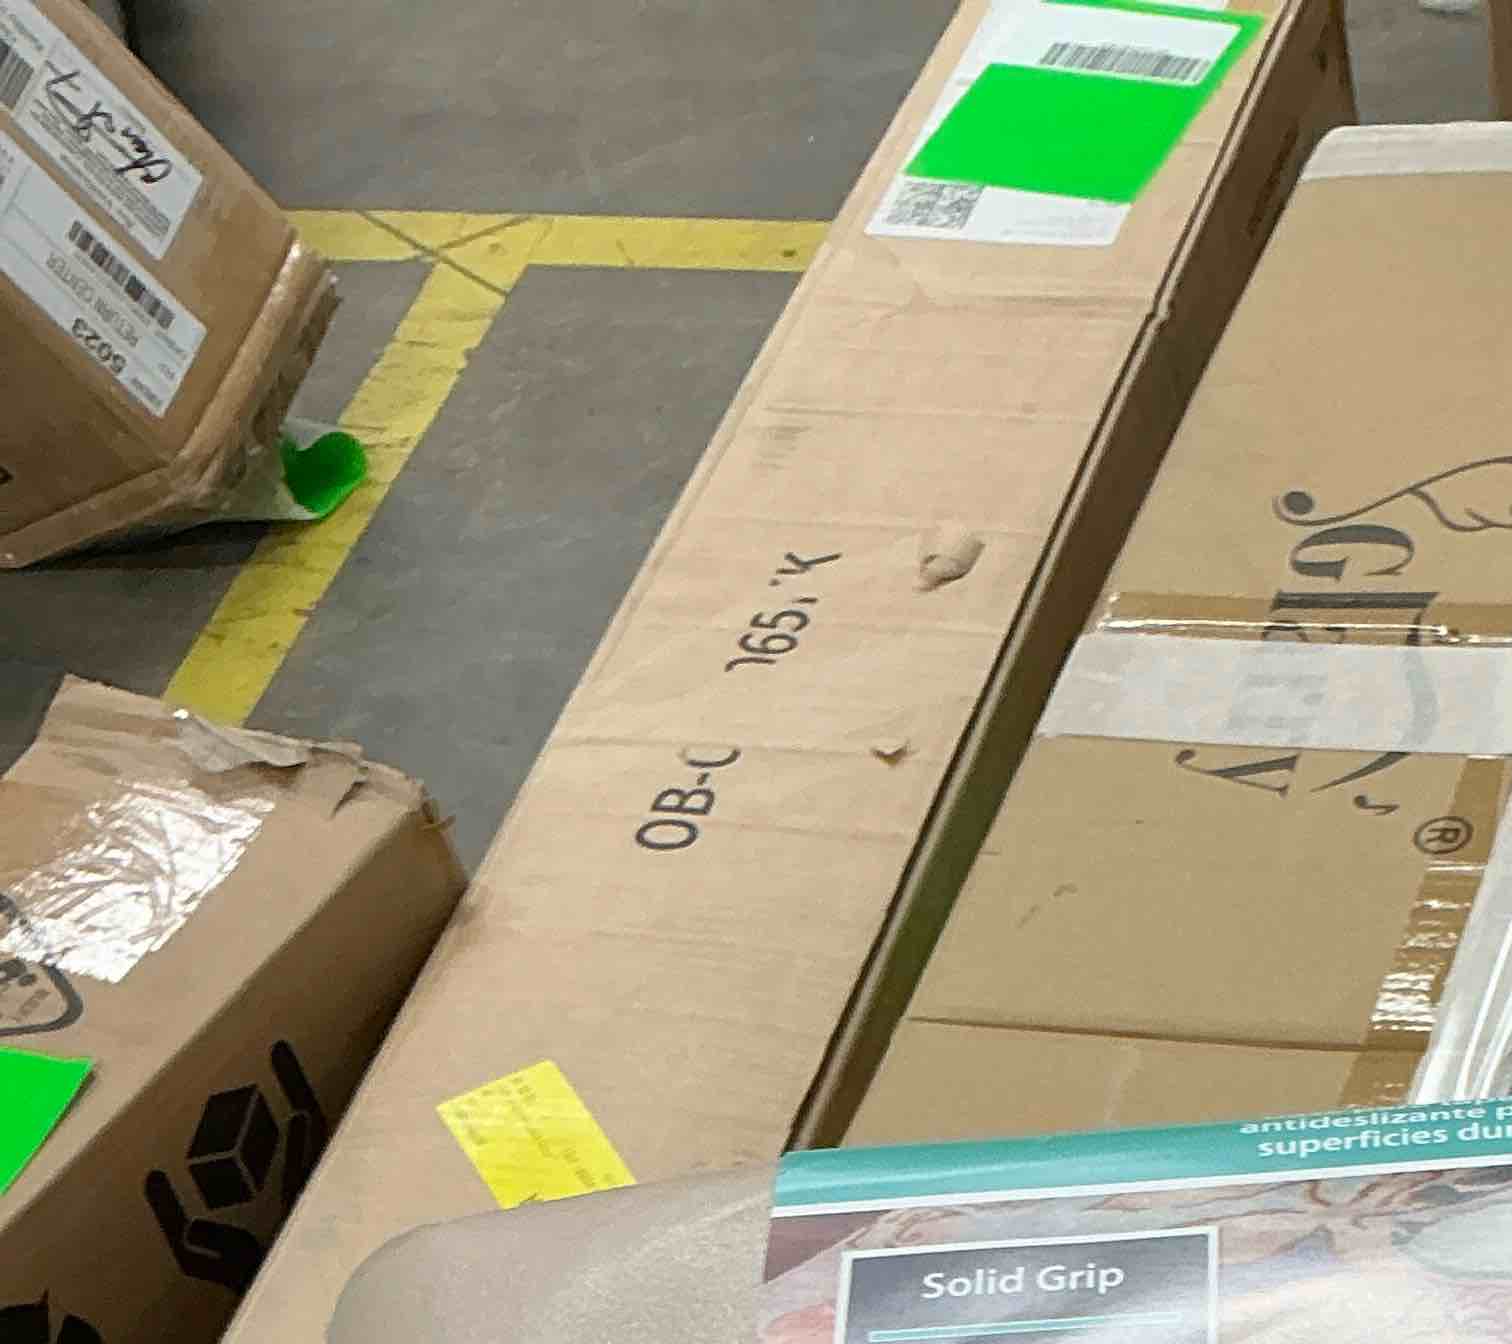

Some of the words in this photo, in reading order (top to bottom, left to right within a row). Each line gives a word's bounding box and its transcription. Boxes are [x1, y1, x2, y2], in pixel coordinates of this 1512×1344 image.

[1239, 1108, 1487, 1135] antideslizante
[1258, 1126, 1449, 1158] superficies
[921, 1266, 1025, 1300] Solid
[1036, 1262, 1125, 1295] Grip
